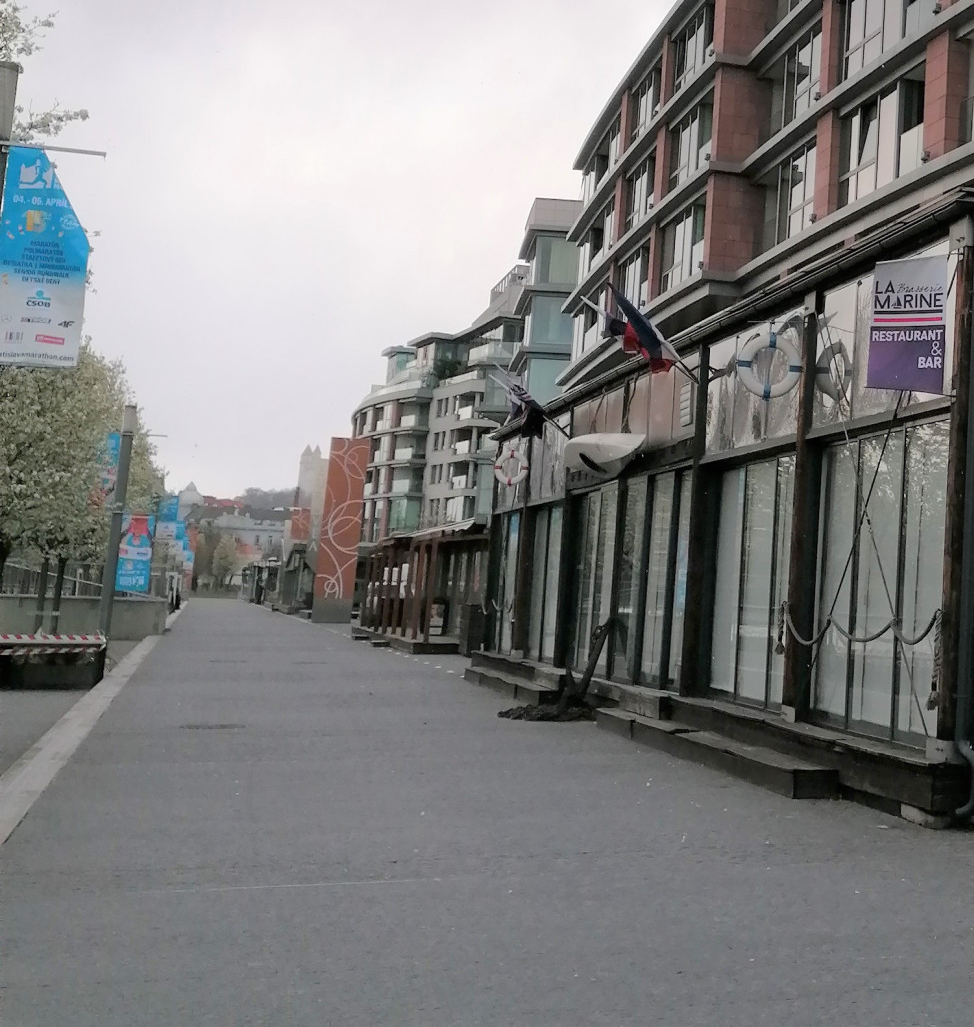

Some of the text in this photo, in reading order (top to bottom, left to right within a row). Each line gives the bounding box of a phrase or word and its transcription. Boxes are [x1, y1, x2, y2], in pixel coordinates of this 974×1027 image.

[874, 280, 943, 294] LA Brasserie
[872, 329, 943, 342] RESTAURANT
[931, 341, 942, 356] &
[917, 356, 942, 369] BAR
